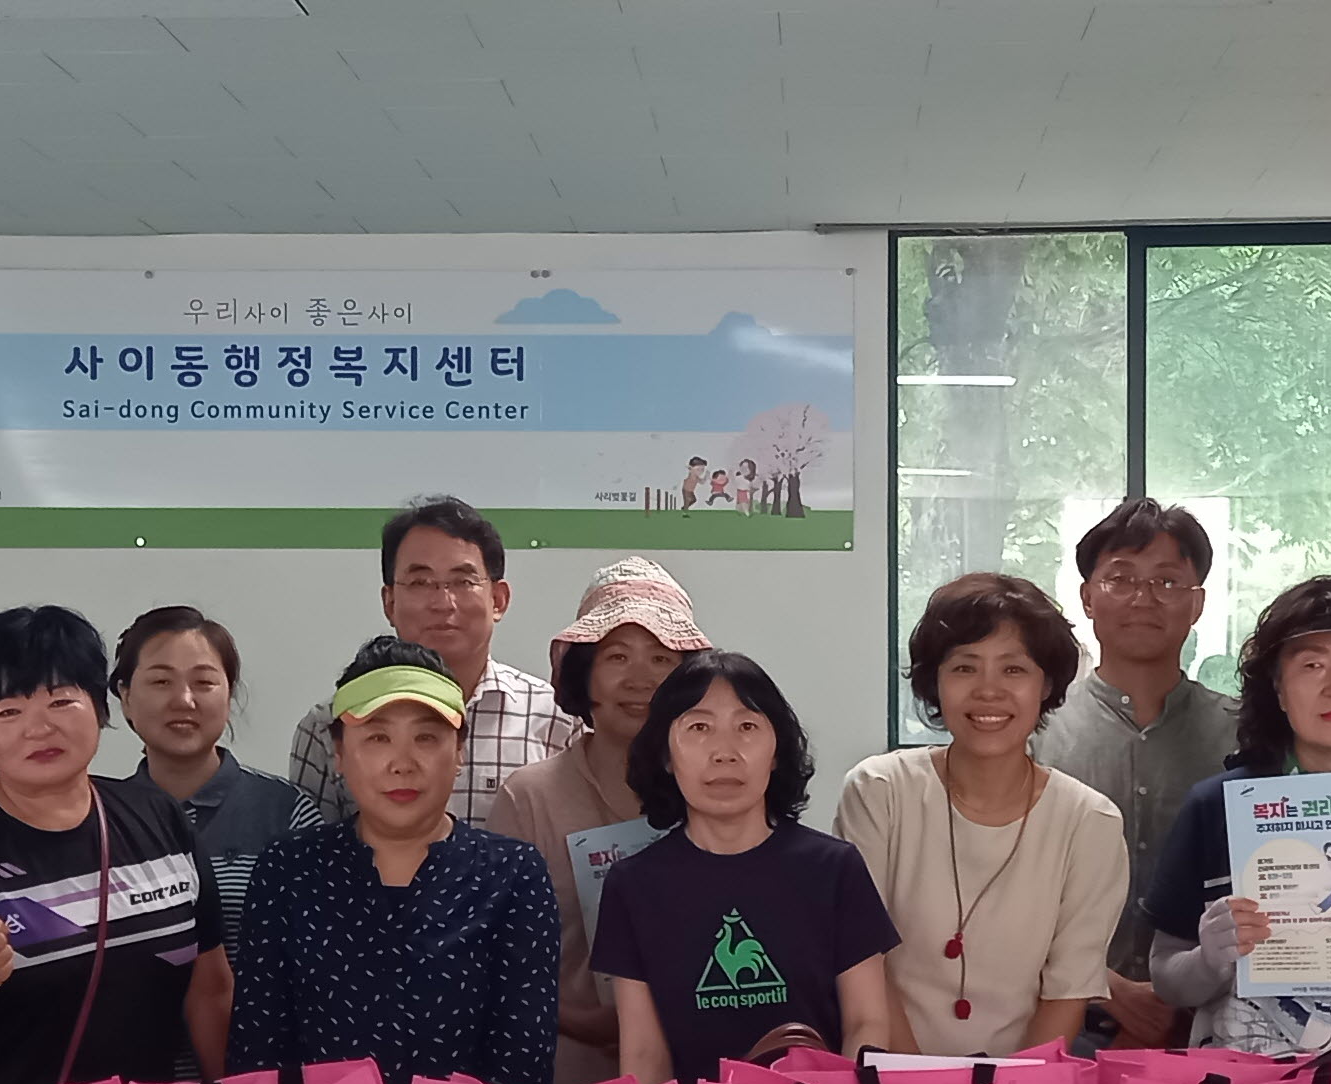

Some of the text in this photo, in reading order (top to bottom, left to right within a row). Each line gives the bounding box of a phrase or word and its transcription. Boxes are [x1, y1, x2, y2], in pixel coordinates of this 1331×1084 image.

[183, 298, 412, 327] 우리사이 좋은사이
[64, 344, 525, 388] 사이동행정복지센터
[62, 399, 530, 424] Sai-dong Community Service Center
[1253, 797, 1299, 819] 복지는
[696, 987, 787, 1009] le coq sportif
